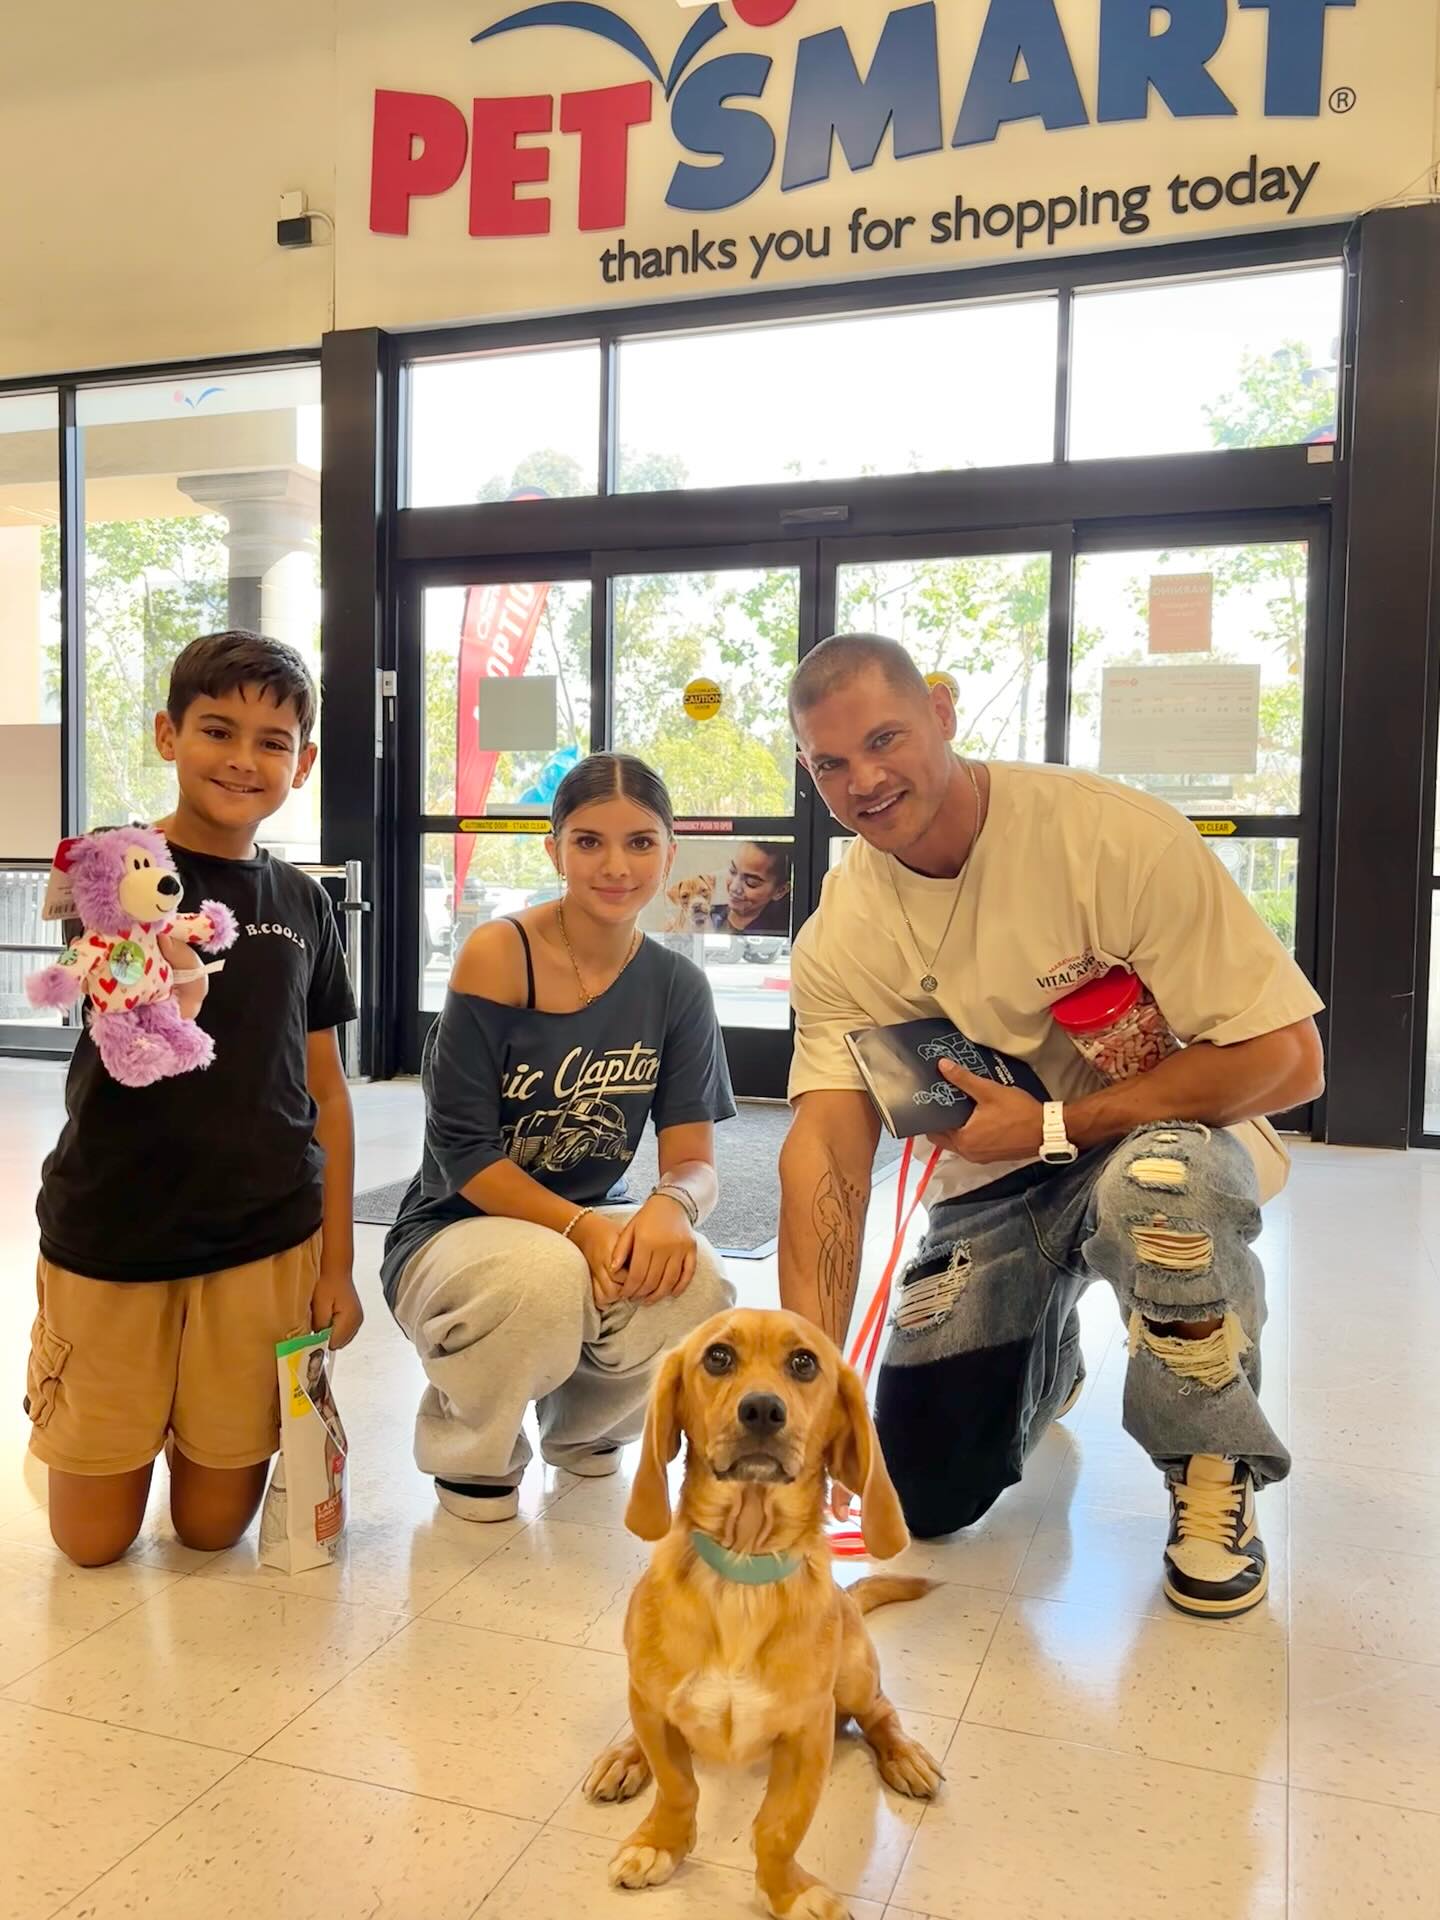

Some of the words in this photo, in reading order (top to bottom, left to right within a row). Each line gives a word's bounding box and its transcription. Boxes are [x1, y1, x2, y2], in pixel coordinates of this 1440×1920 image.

[600, 229, 737, 283] thanks
[750, 226, 830, 279] you
[848, 207, 916, 253] for
[931, 195, 1151, 248] shopping
[1167, 154, 1320, 215] today
[683, 694, 721, 704] CAUTION
[1206, 823, 1229, 832] CLEAR
[1036, 971, 1076, 988] VITAL
[554, 1041, 661, 1104] Clapton
